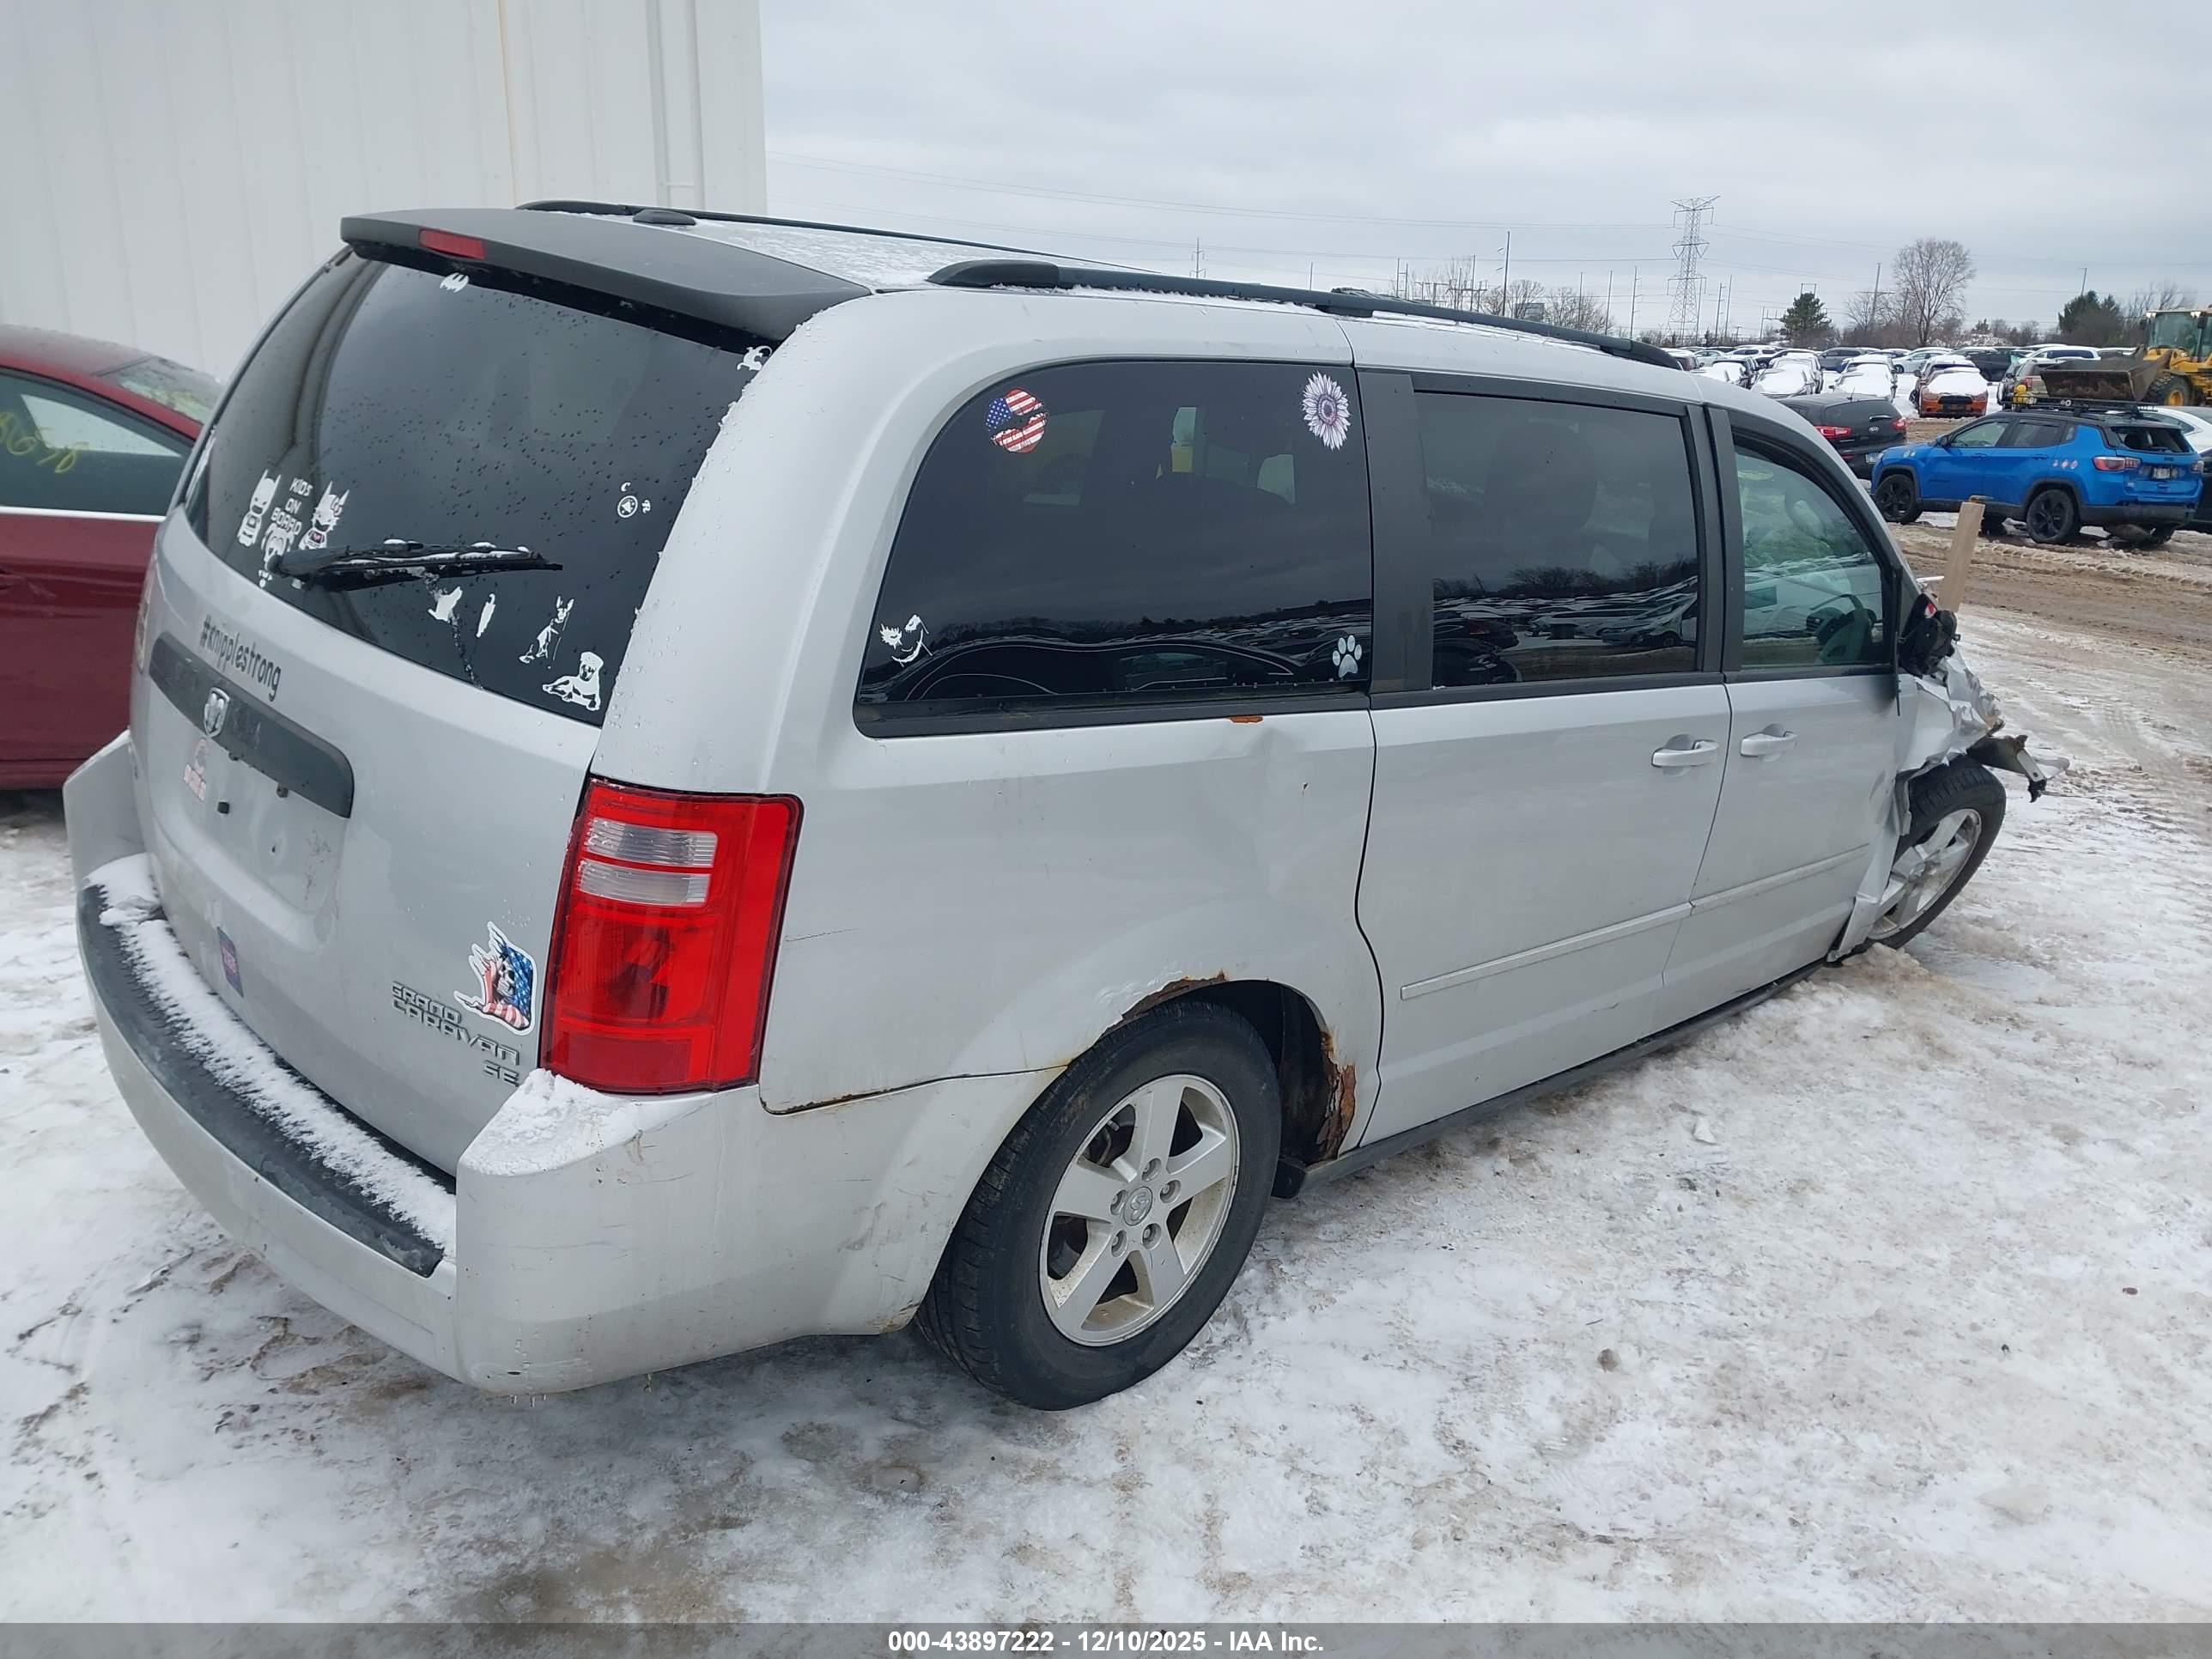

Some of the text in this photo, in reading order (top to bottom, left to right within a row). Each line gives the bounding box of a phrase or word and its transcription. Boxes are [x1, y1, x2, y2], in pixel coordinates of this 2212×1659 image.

[289, 477, 313, 495] KIDS
[285, 498, 302, 514] ON
[270, 507, 302, 535] BOARD
[392, 981, 461, 1024] GRAND
[392, 998, 520, 1066] CARAVAN
[483, 1060, 520, 1087] SE
